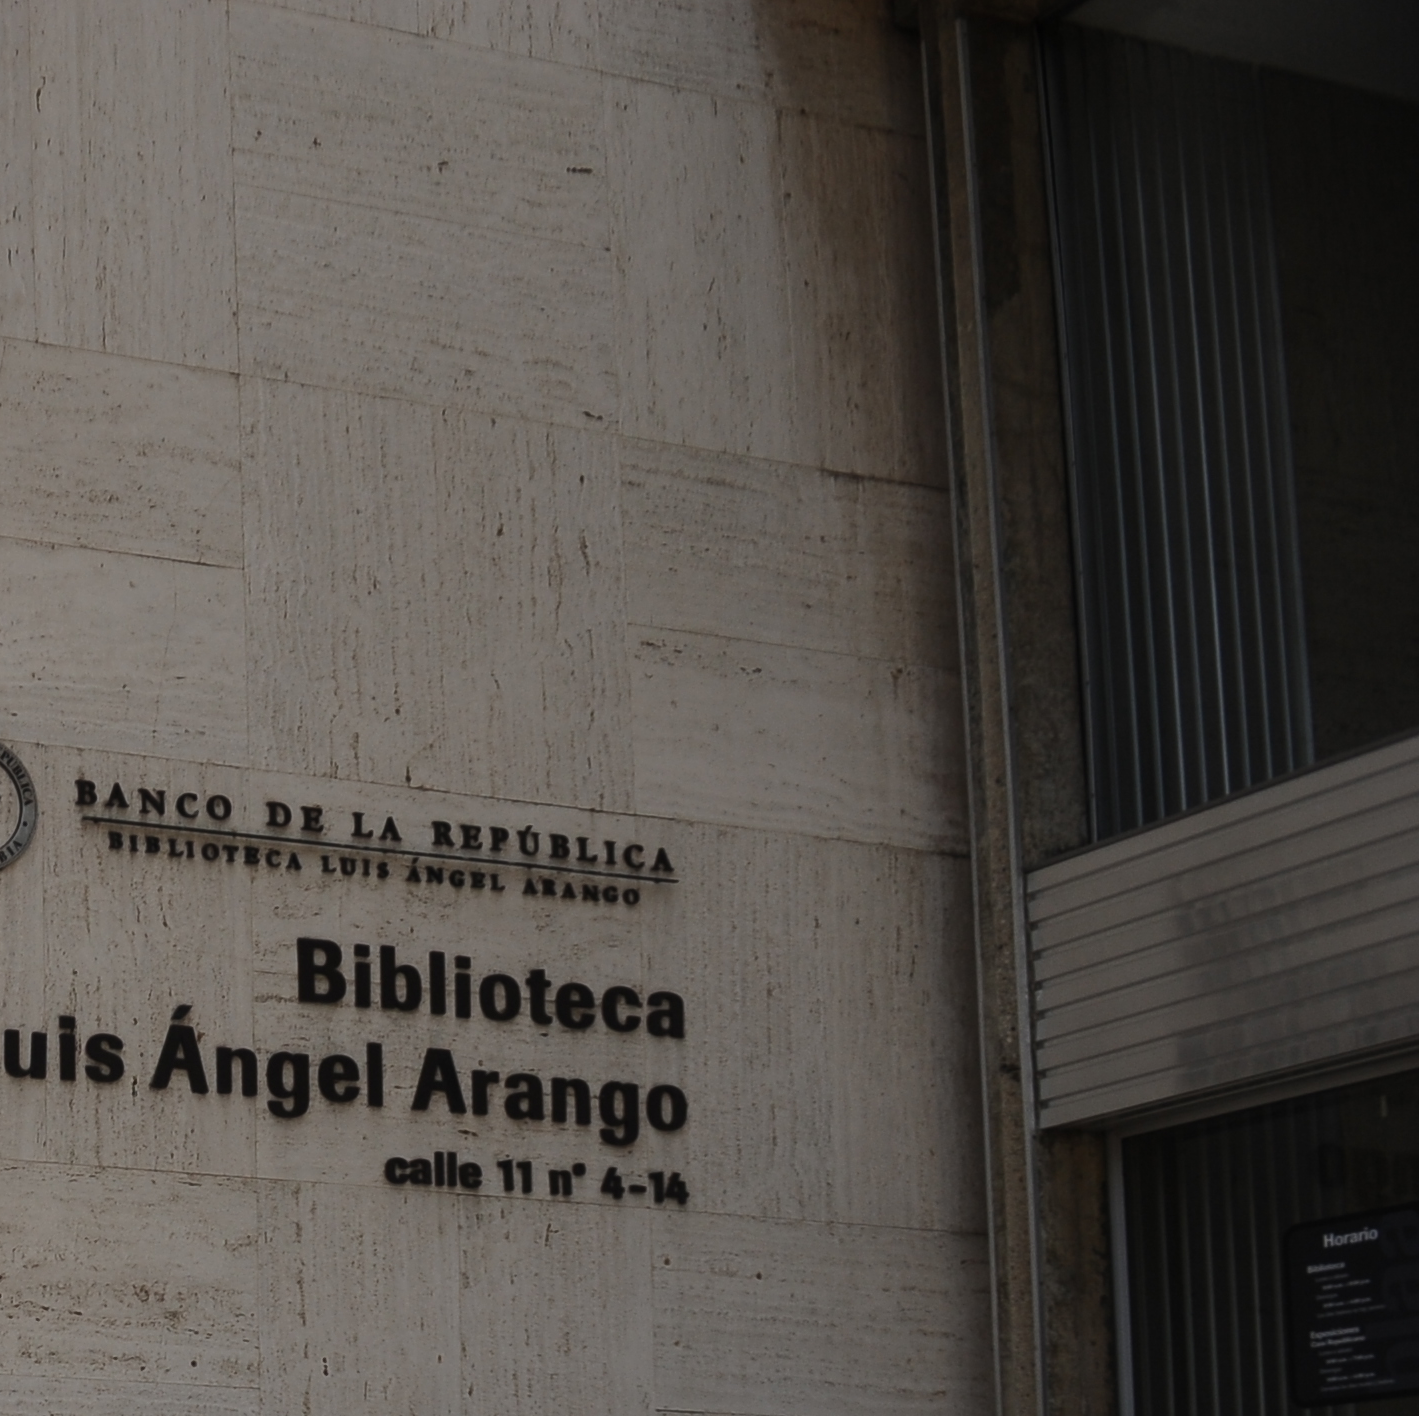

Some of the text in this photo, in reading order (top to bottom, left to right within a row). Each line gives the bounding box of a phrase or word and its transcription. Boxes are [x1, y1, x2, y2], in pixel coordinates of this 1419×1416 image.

[74, 779, 675, 873] BANCO DE LA REPÚBLICA
[108, 831, 641, 906] BIBLIOTECA LUIS ÁNGEL ARANGO
[296, 937, 685, 1040] Biblioteca
[149, 1004, 384, 1119] Ángel
[411, 1047, 688, 1147] Arango
[384, 1150, 483, 1189] calle
[497, 1158, 533, 1194] 11
[600, 1166, 690, 1206] 4-14
[1322, 1227, 1379, 1249] Horario
